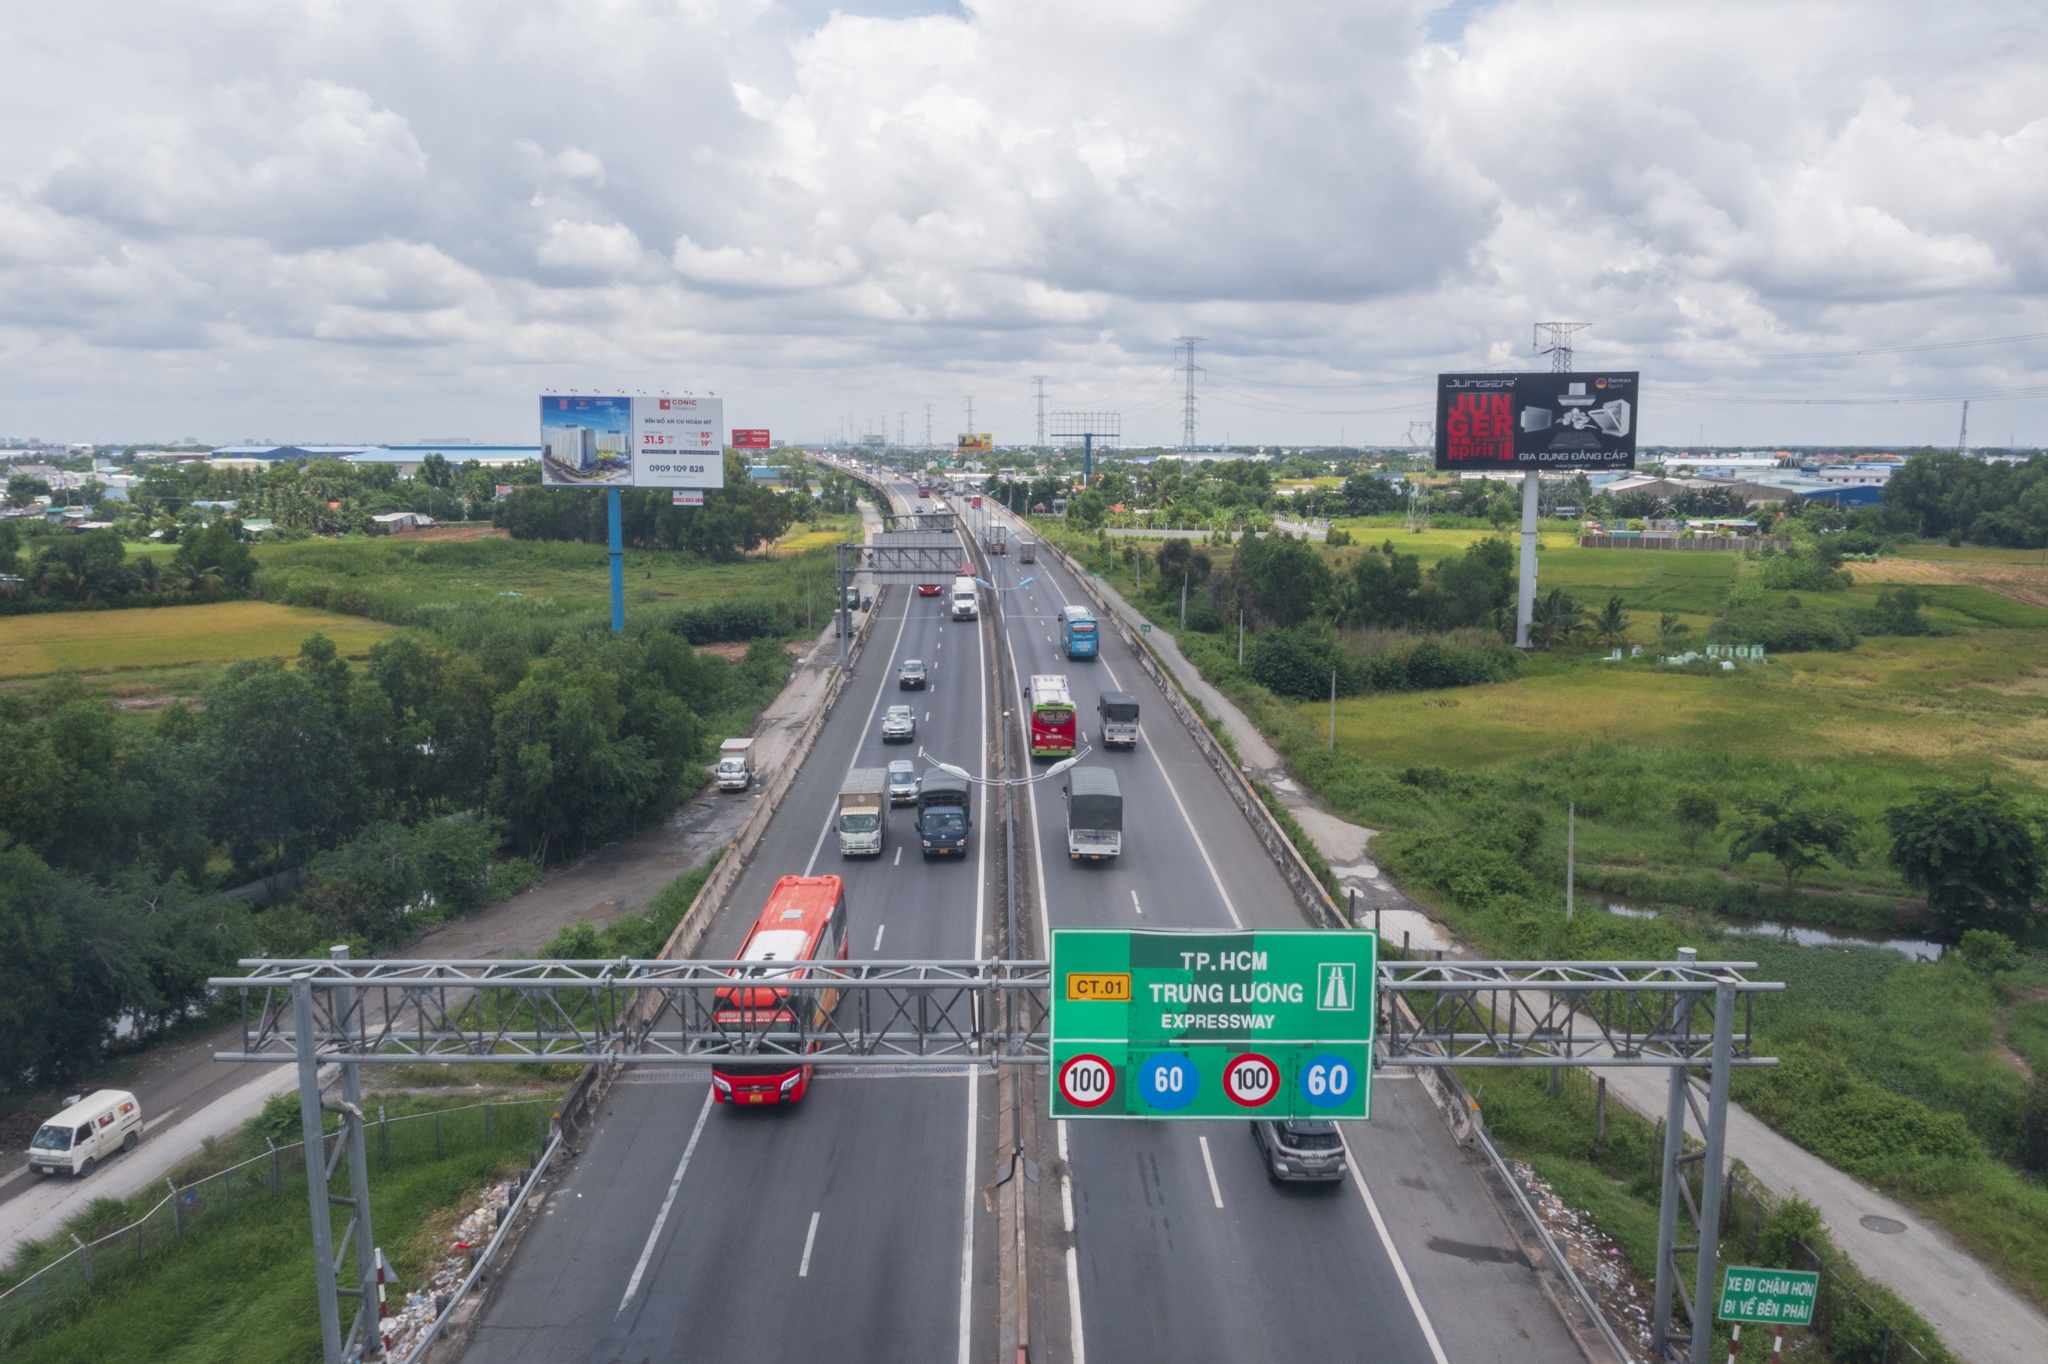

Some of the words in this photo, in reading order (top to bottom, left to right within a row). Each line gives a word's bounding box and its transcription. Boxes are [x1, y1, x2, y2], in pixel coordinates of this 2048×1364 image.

[1448, 393, 1511, 415] JUN
[1447, 414, 1514, 436] GER
[644, 435, 664, 444] 31.5
[1450, 443, 1495, 460] spirit
[1539, 453, 1569, 461] DỤNG
[1571, 450, 1601, 460] ĐẲNG
[1604, 449, 1628, 460] CẤP
[1180, 951, 1268, 971] TP.HCM
[1076, 980, 1122, 995] CT.01
[1149, 983, 1224, 1003] TRUNG
[1230, 981, 1303, 1003] LƯƠNG
[1161, 1013, 1275, 1028] EXPRESSWAY
[1070, 1067, 1105, 1092] 100
[1154, 1066, 1183, 1092] 60
[1234, 1067, 1269, 1090] 100
[1308, 1064, 1348, 1095] 60
[1728, 1277, 1742, 1292] XE
[1744, 1278, 1755, 1292] ĐI
[1758, 1277, 1789, 1297] CHẬM
[1791, 1281, 1814, 1296] HƠN
[1724, 1300, 1736, 1314] ĐI
[1740, 1296, 1757, 1315] VỀ
[1757, 1299, 1780, 1317] BÊN
[1782, 1301, 1810, 1319] PHẢI
